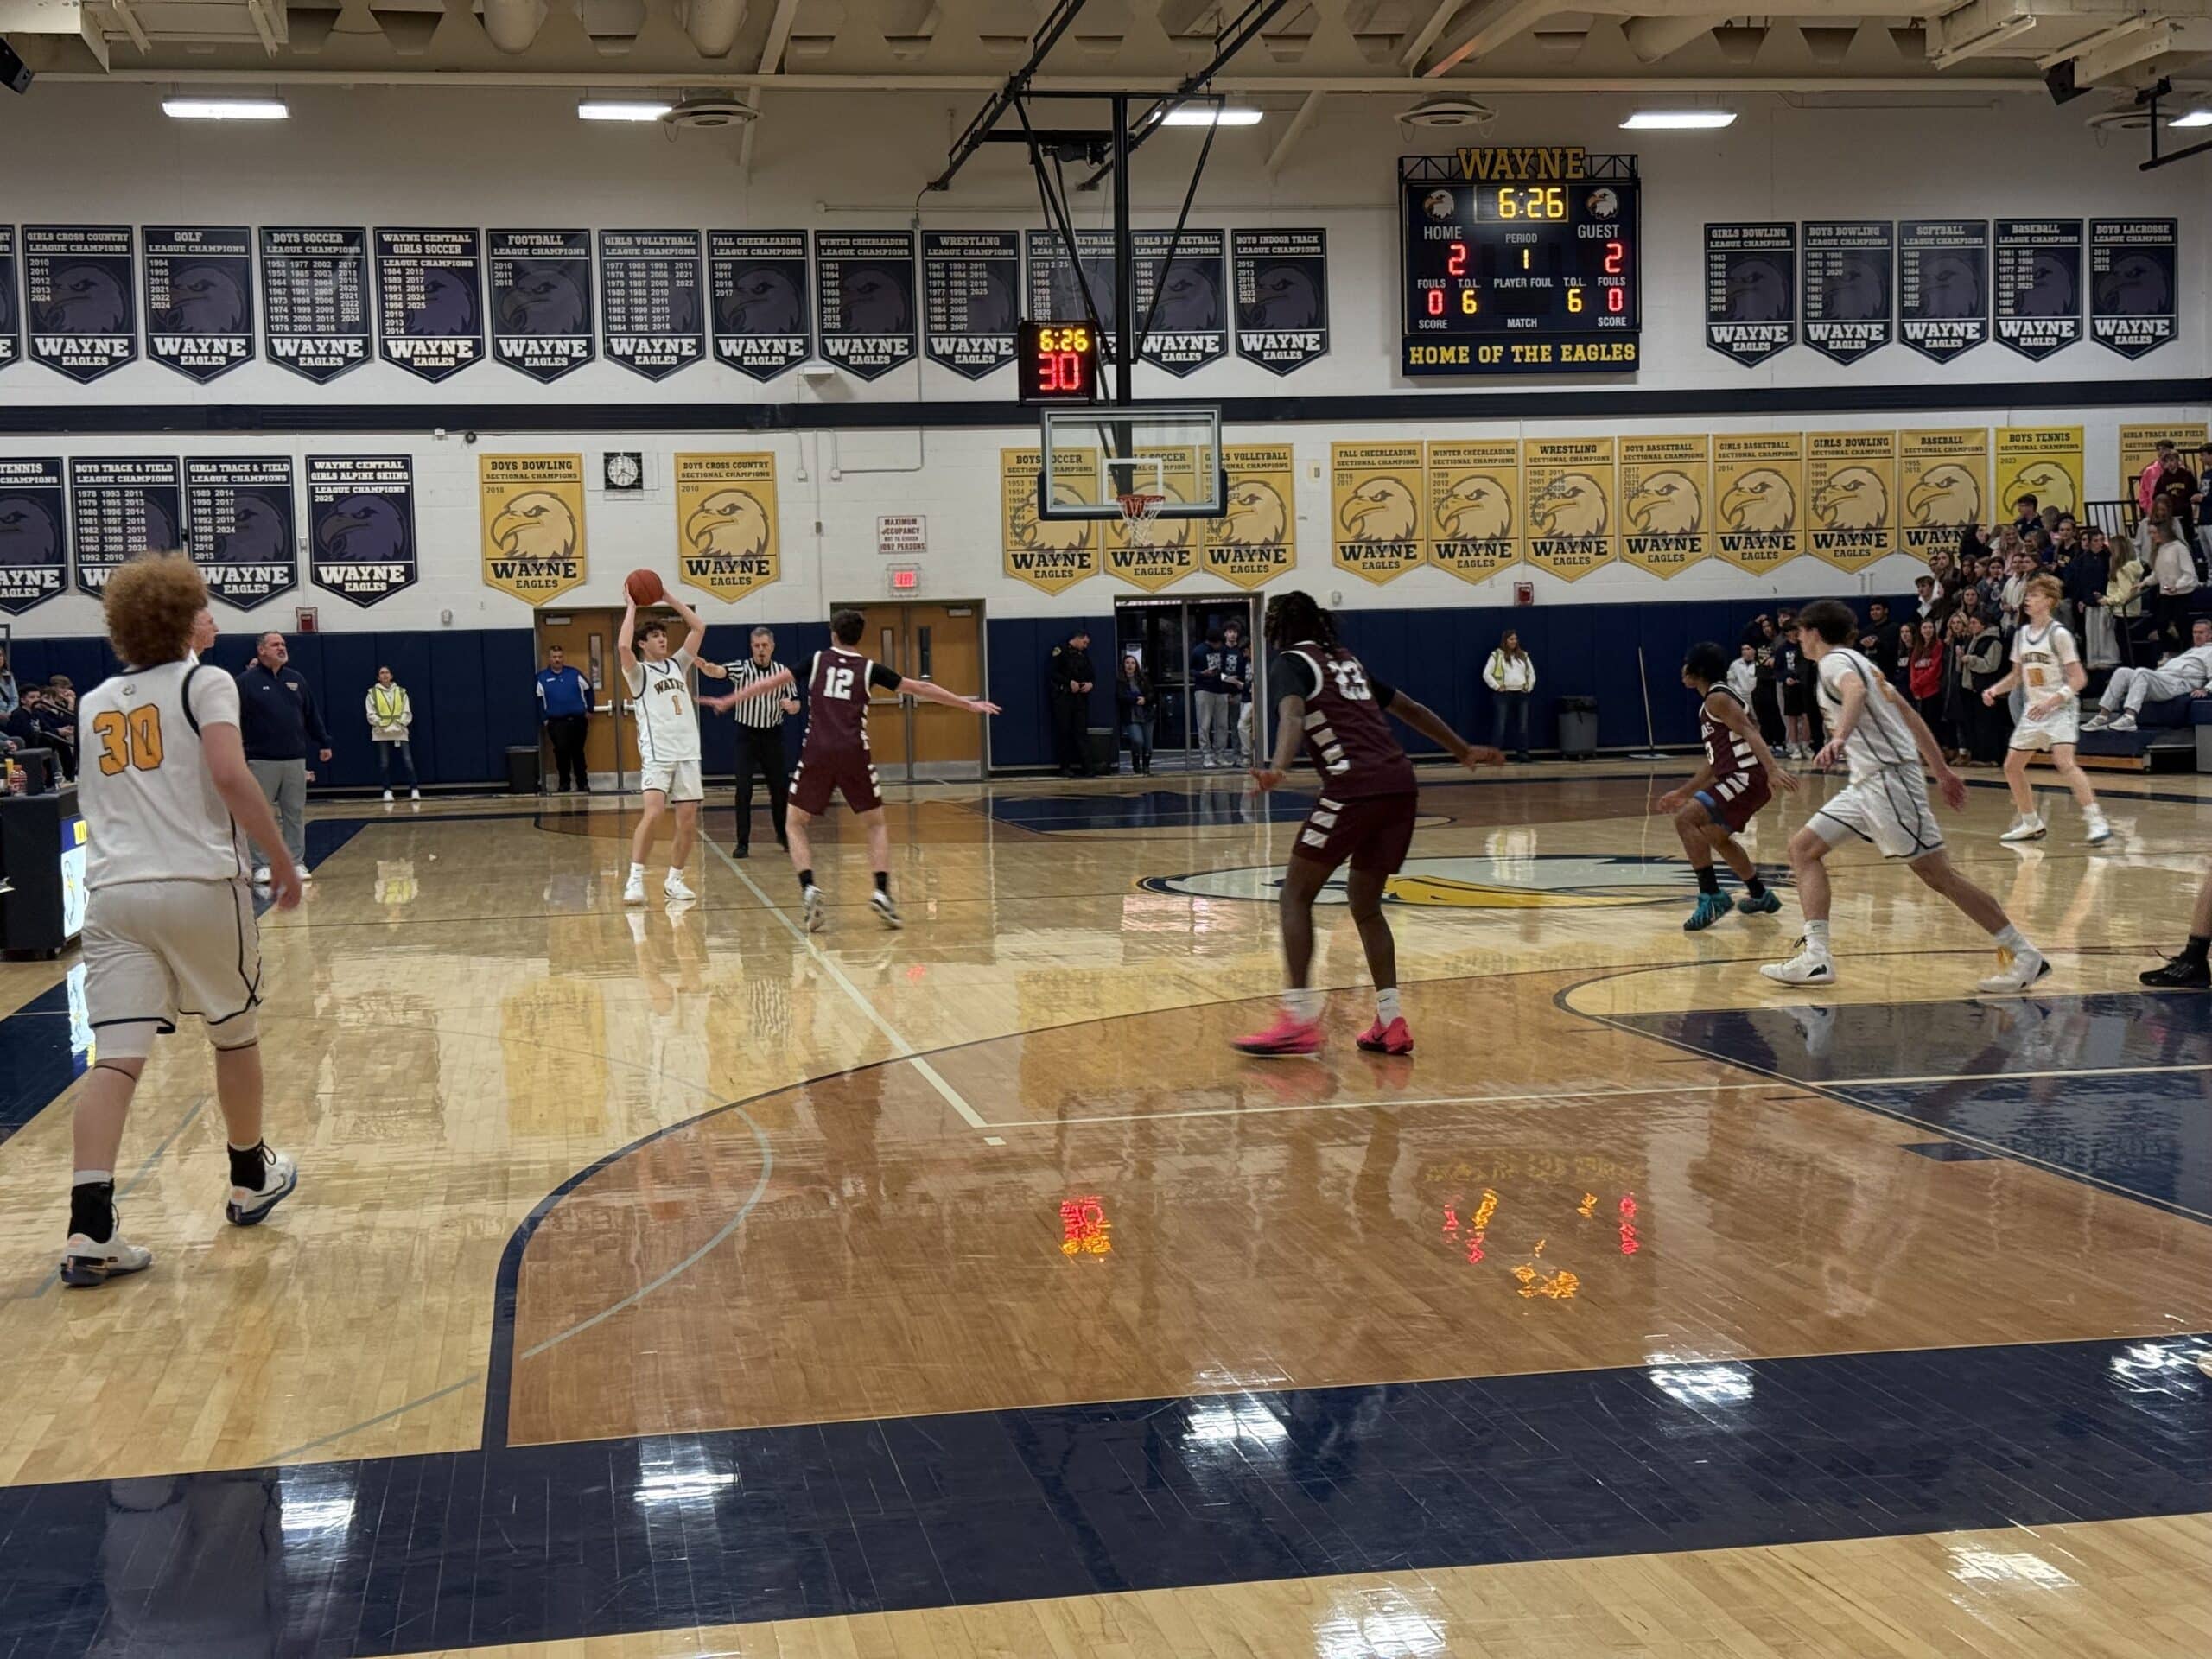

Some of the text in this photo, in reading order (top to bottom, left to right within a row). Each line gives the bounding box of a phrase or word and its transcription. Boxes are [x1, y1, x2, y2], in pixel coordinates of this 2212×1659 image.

[1457, 147, 1585, 180] WAYNE
[1498, 188, 1563, 218] 6:26
[1424, 226, 1462, 240] HOME
[1578, 225, 1619, 238] GUEST
[1712, 228, 1787, 238] GIRLS BOWLING
[1809, 226, 1880, 236] BOYS BOWLING
[1916, 226, 1965, 235] SOFTBALL
[2096, 225, 2170, 234] BOYS LACROSSE
[27, 233, 129, 242] GIRLS CROSS COUNTRY
[174, 232, 202, 242] GOLF
[273, 233, 343, 244] BOYS SOCCER
[383, 234, 472, 243] WAYNE CENTRAL
[508, 235, 563, 245] FOOTBALL
[605, 236, 696, 245] GIRLS VOLLEYBALL
[737, 237, 802, 245] CHEERLEADING
[939, 237, 1000, 245] WRESTLING
[1134, 236, 1160, 245] GIRLS
[1292, 235, 1318, 244] TRACK
[1505, 233, 1538, 243] PERIOD
[393, 245, 461, 254] GIRLS SOCCER
[1448, 244, 1465, 275] 2
[1522, 249, 1529, 269] 1
[1605, 244, 1623, 273] 2
[1418, 278, 1446, 289] FOULS
[1494, 278, 1554, 288] PLAYER FOUL
[1598, 276, 1626, 286] FOULS
[1428, 290, 1443, 315] 0
[1462, 290, 1477, 314] 6
[1568, 289, 1582, 312] 6
[1608, 288, 1623, 311] 0
[1419, 320, 1447, 329] SCORE
[1507, 318, 1537, 327] MATCH
[1598, 317, 1626, 327] SCORE
[2094, 319, 2170, 336] WAYNE
[1711, 326, 1788, 343] WAYNE
[1808, 324, 1884, 340] WAYNE
[1904, 322, 1980, 339] WAYNE
[1999, 321, 2074, 337] WAYNE
[1039, 329, 1088, 352] 6:26
[1141, 335, 1219, 353] WAYNE
[1240, 334, 1320, 352] WAYNE
[1828, 340, 1866, 349] EAGLES
[1925, 339, 1963, 348] EAGLES
[2020, 337, 2056, 346] EAGLES
[2115, 335, 2152, 345] EAGLES
[35, 338, 129, 357] WAYNE
[153, 338, 246, 357] WAYNE
[272, 339, 363, 357] WAYNE
[387, 340, 474, 359] WAYNE
[499, 339, 588, 357] WAYNE
[610, 338, 696, 356] WAYNE
[719, 339, 804, 357] WAYNE
[825, 339, 908, 356] WAYNE
[931, 337, 1014, 355] WAYNE
[1733, 342, 1770, 351] EAGLES
[634, 355, 677, 365] EAGLES
[743, 355, 785, 365] EAGLES
[849, 355, 890, 365] EAGLES
[955, 353, 995, 364] EAGLES
[1161, 353, 1202, 362] EAGLES
[1262, 351, 1303, 360] EAGLES
[1410, 344, 1635, 365] HOME OF THE EAGLES
[62, 356, 108, 367] EAGLES
[181, 355, 226, 366] EAGLES
[298, 356, 343, 367] EAGLES
[413, 357, 455, 366] EAGLES
[524, 356, 568, 366] EAGLES
[1038, 353, 1078, 390] 30
[1814, 437, 1889, 448] GIRLS BOWLING
[1921, 436, 1963, 445] BASEBALL
[2009, 433, 2070, 442] BOYS TENNIS
[1540, 445, 1597, 454] WRESTLING
[0, 463, 43, 474] TENNIS
[75, 464, 173, 474] BOYS TRACK & FIELD
[189, 463, 289, 474] GIRLS TRACK & FIELD
[314, 461, 404, 470] WAYNE CENTRAL
[491, 461, 573, 471] BOYS BOWLING
[310, 471, 409, 480] GIRLS ALPINE SKIING
[1626, 537, 1702, 554] WAYNE
[1720, 536, 1796, 550] WAYNE
[1813, 533, 1888, 549] WAYNE
[1339, 544, 1417, 561] WAYNE
[1435, 543, 1512, 559] WAYNE
[1532, 541, 1608, 556] WAYNE
[1834, 549, 1871, 557] EAGLES
[1012, 554, 1091, 569] WAYNE
[1111, 550, 1191, 567] WAYNE
[1209, 549, 1287, 564] WAYNE
[1553, 556, 1591, 566] EAGLES
[1648, 553, 1685, 563] EAGLES
[1741, 551, 1778, 561] EAGLES
[686, 560, 770, 576] WAYNE
[1230, 564, 1269, 574] EAGLES
[1362, 561, 1400, 569] EAGLES
[1457, 559, 1495, 569] EAGLES
[204, 567, 289, 585] WAYNE
[319, 566, 405, 584] WAYNE
[492, 563, 577, 579] WAYNE
[1034, 569, 1073, 579] EAGLES
[1134, 567, 1173, 576] EAGLES
[345, 581, 387, 592] EAGLES
[516, 578, 558, 588] EAGLES
[710, 576, 752, 586] EAGLES
[224, 583, 269, 594] EAGLES
[823, 667, 854, 700] 12
[672, 695, 683, 715] 1
[93, 703, 163, 776] 30
